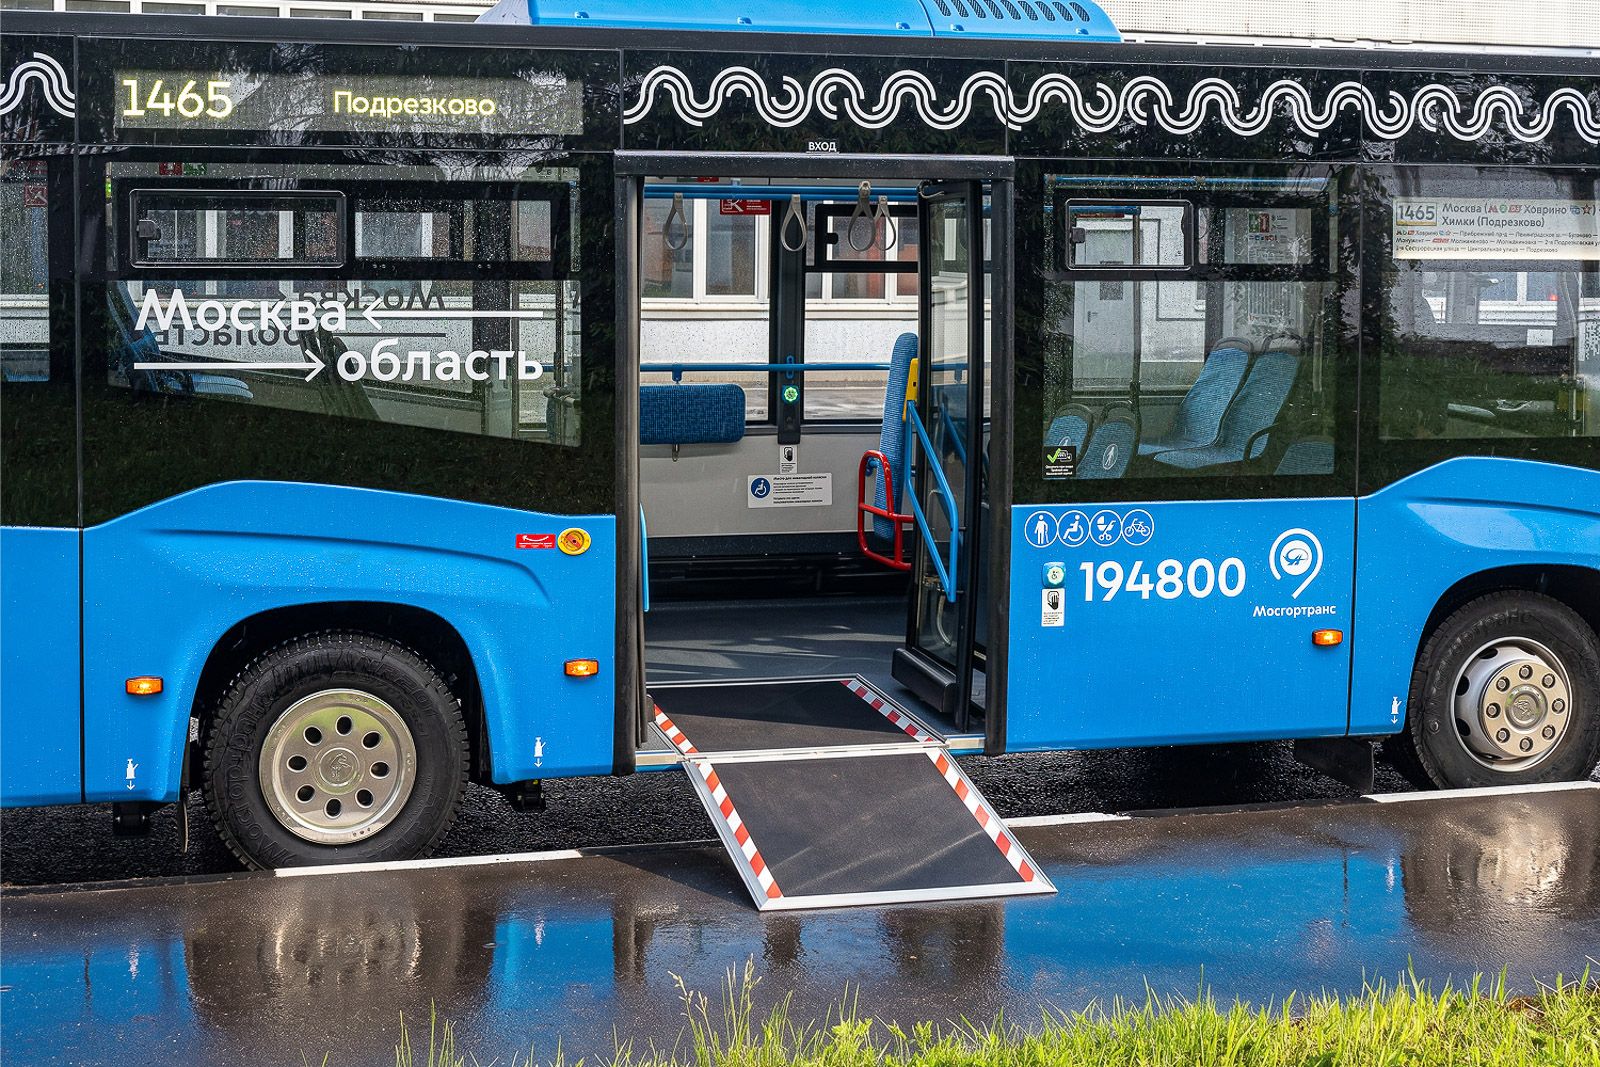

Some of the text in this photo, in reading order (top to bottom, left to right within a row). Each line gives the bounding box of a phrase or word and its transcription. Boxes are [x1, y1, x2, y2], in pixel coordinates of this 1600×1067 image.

[122, 79, 497, 118] 1465 Подрезково
[808, 141, 837, 152] ВХОД
[1398, 205, 1435, 221] 1465
[1442, 203, 1482, 213] Москва
[1442, 216, 1545, 229] Химки (Подрезково)
[133, 288, 348, 332] Москва
[336, 338, 545, 382] область
[1079, 557, 1247, 602] 194800
[1252, 605, 1337, 618] Мосгортранс
